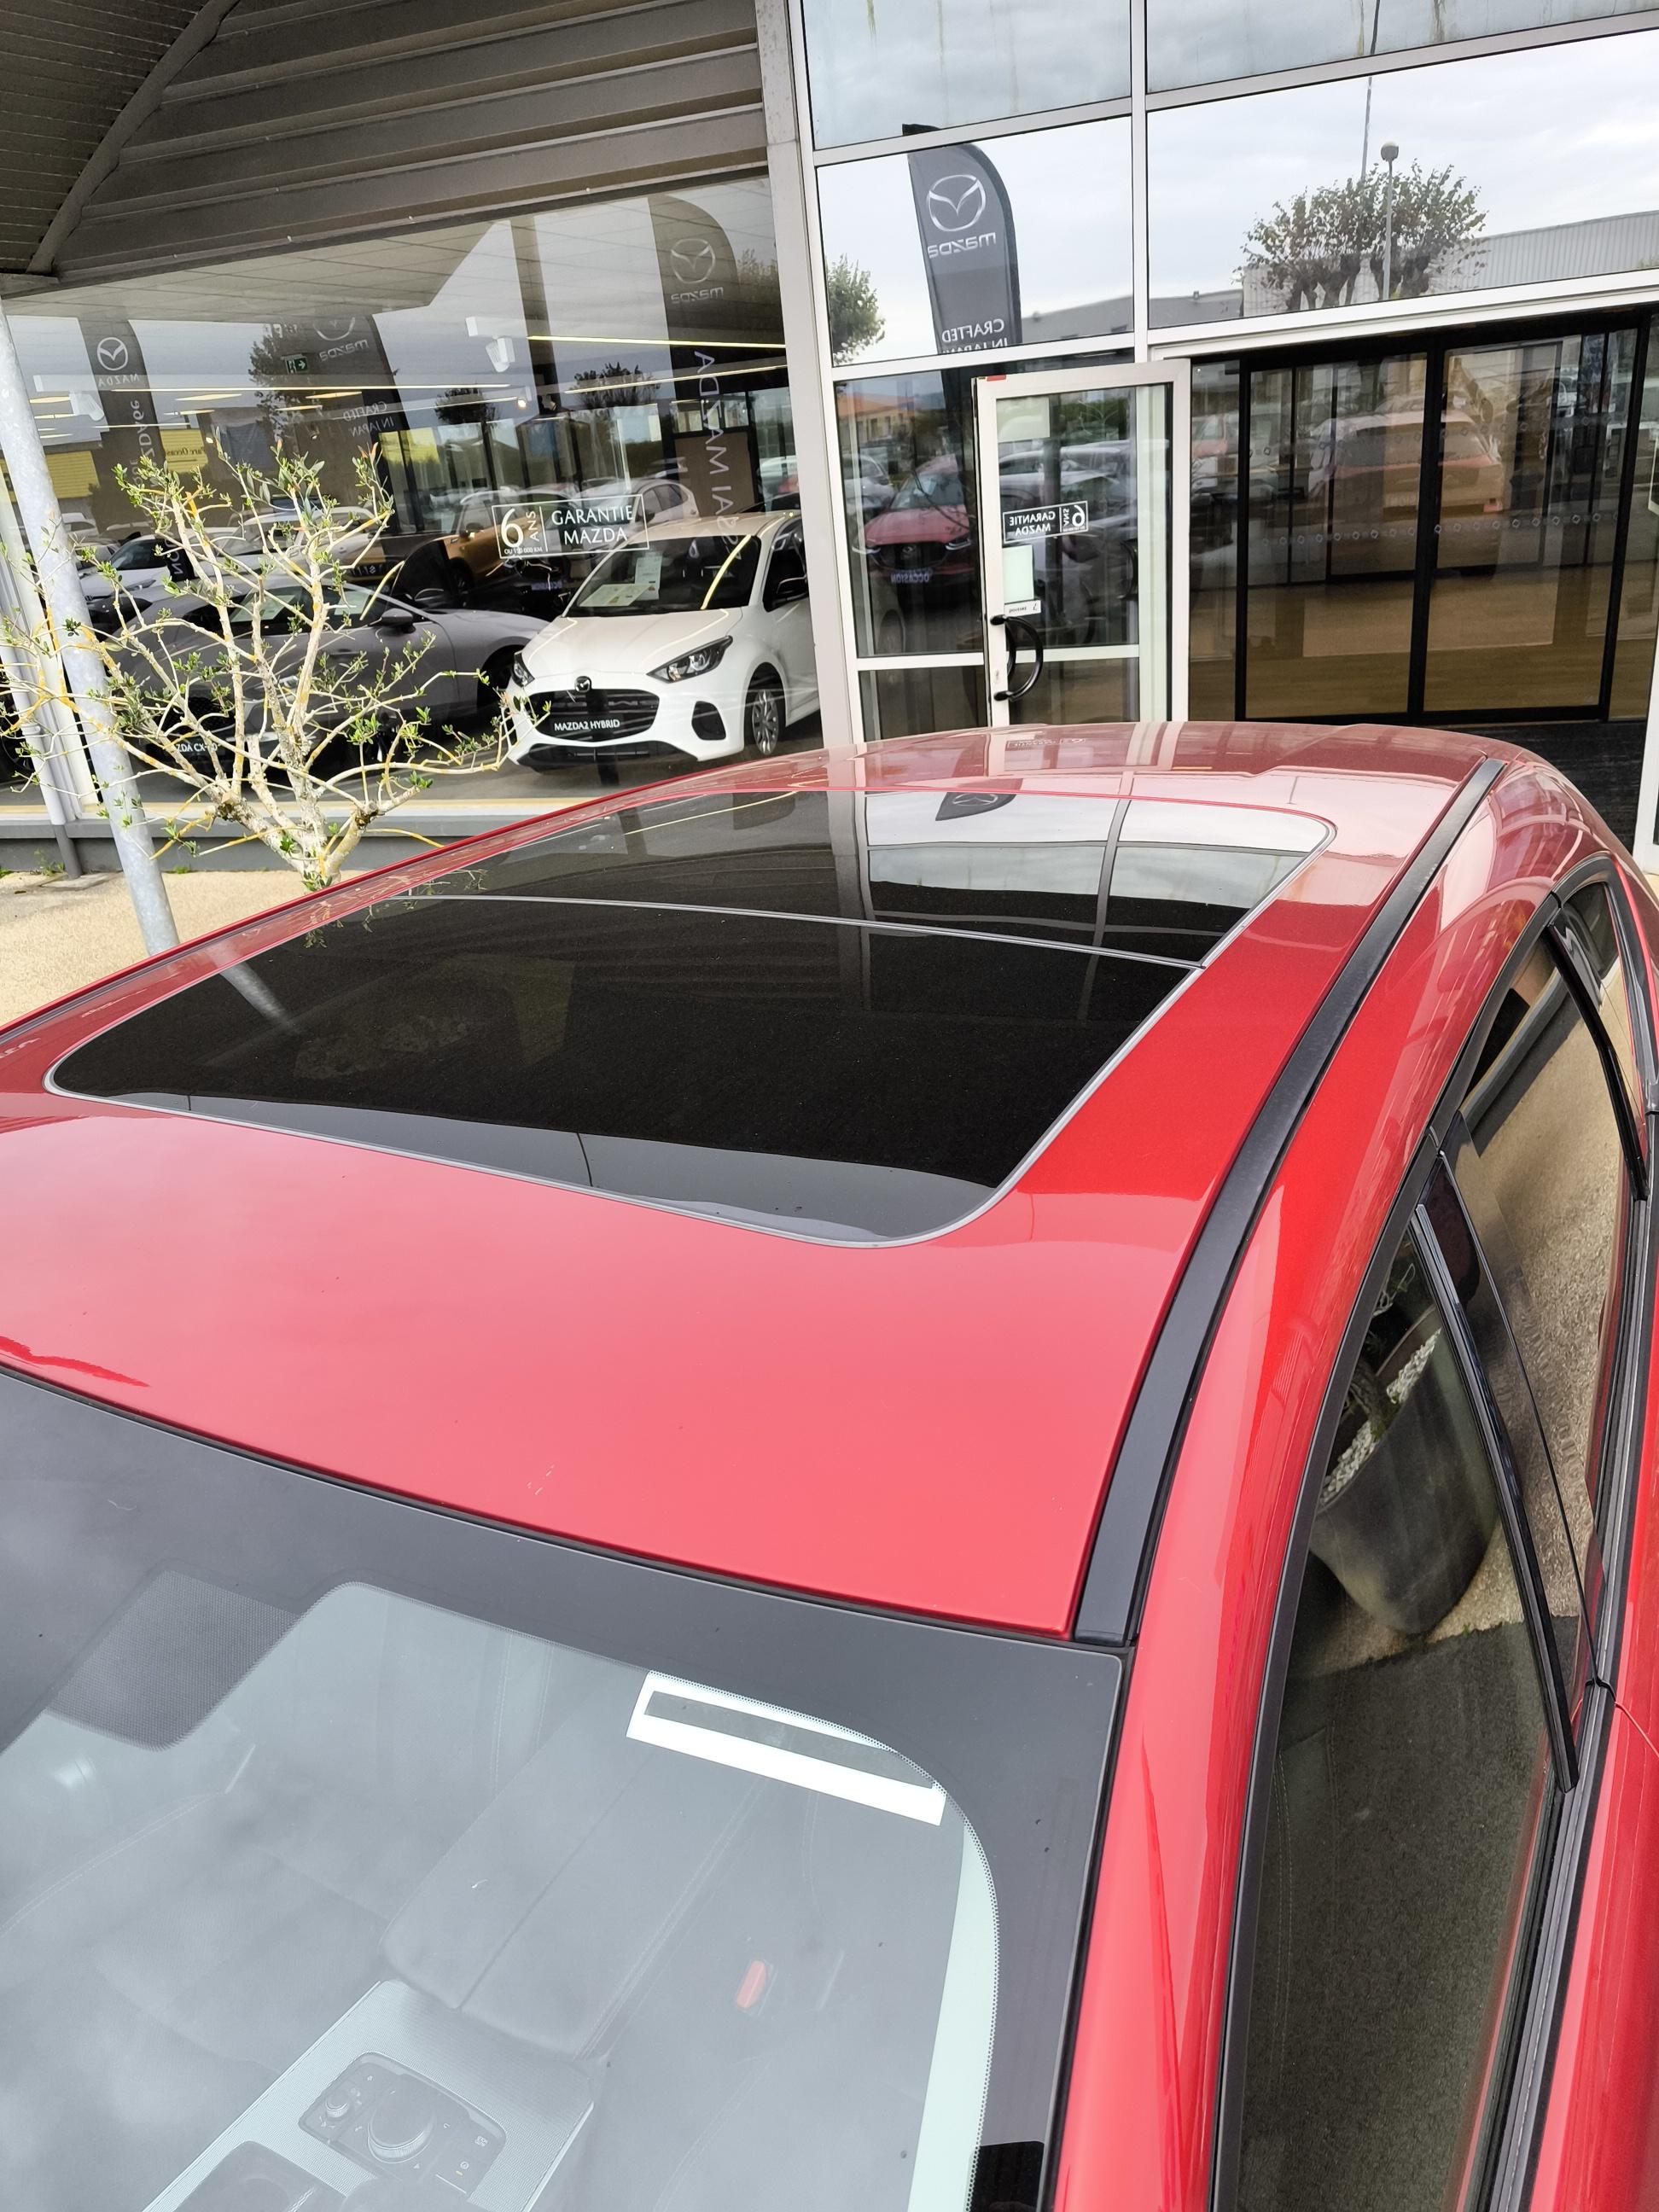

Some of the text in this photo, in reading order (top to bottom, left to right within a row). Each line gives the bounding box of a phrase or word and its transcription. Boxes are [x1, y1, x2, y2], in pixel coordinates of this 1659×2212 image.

[551, 504, 633, 526] GARANTIE
[500, 507, 540, 548] 6 ANS
[563, 527, 628, 545] MAZDA
[554, 719, 620, 731] MAZDA2 HYBRID
[176, 742, 218, 752] ZDA CX-0
